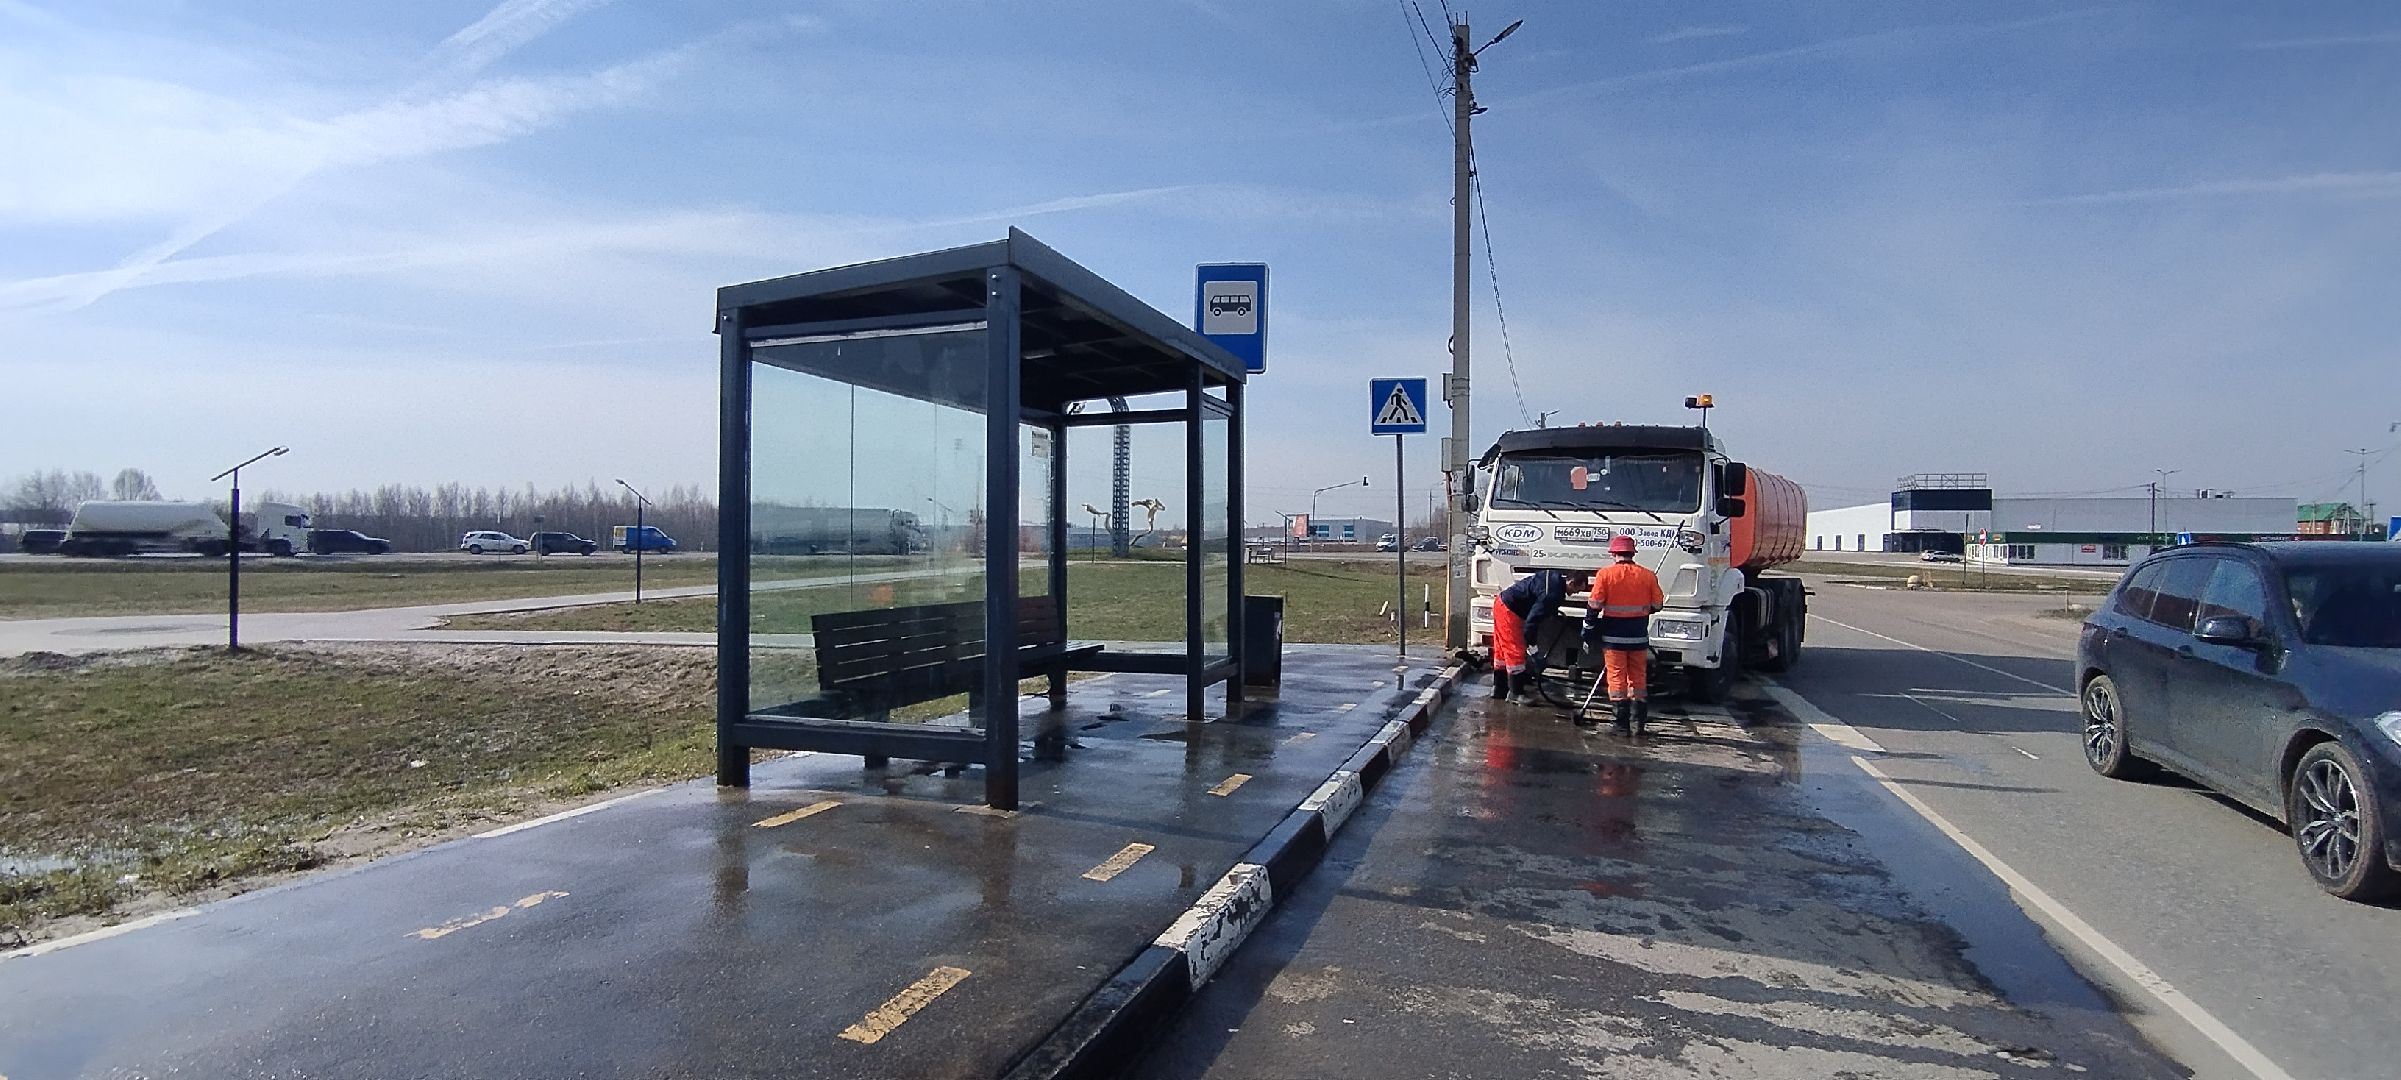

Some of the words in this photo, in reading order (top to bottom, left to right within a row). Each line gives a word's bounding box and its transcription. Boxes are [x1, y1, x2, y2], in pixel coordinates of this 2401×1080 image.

[1504, 528, 1536, 538] KDM
[1619, 527, 1636, 536] ООО
[1638, 527, 1659, 538] Завод
